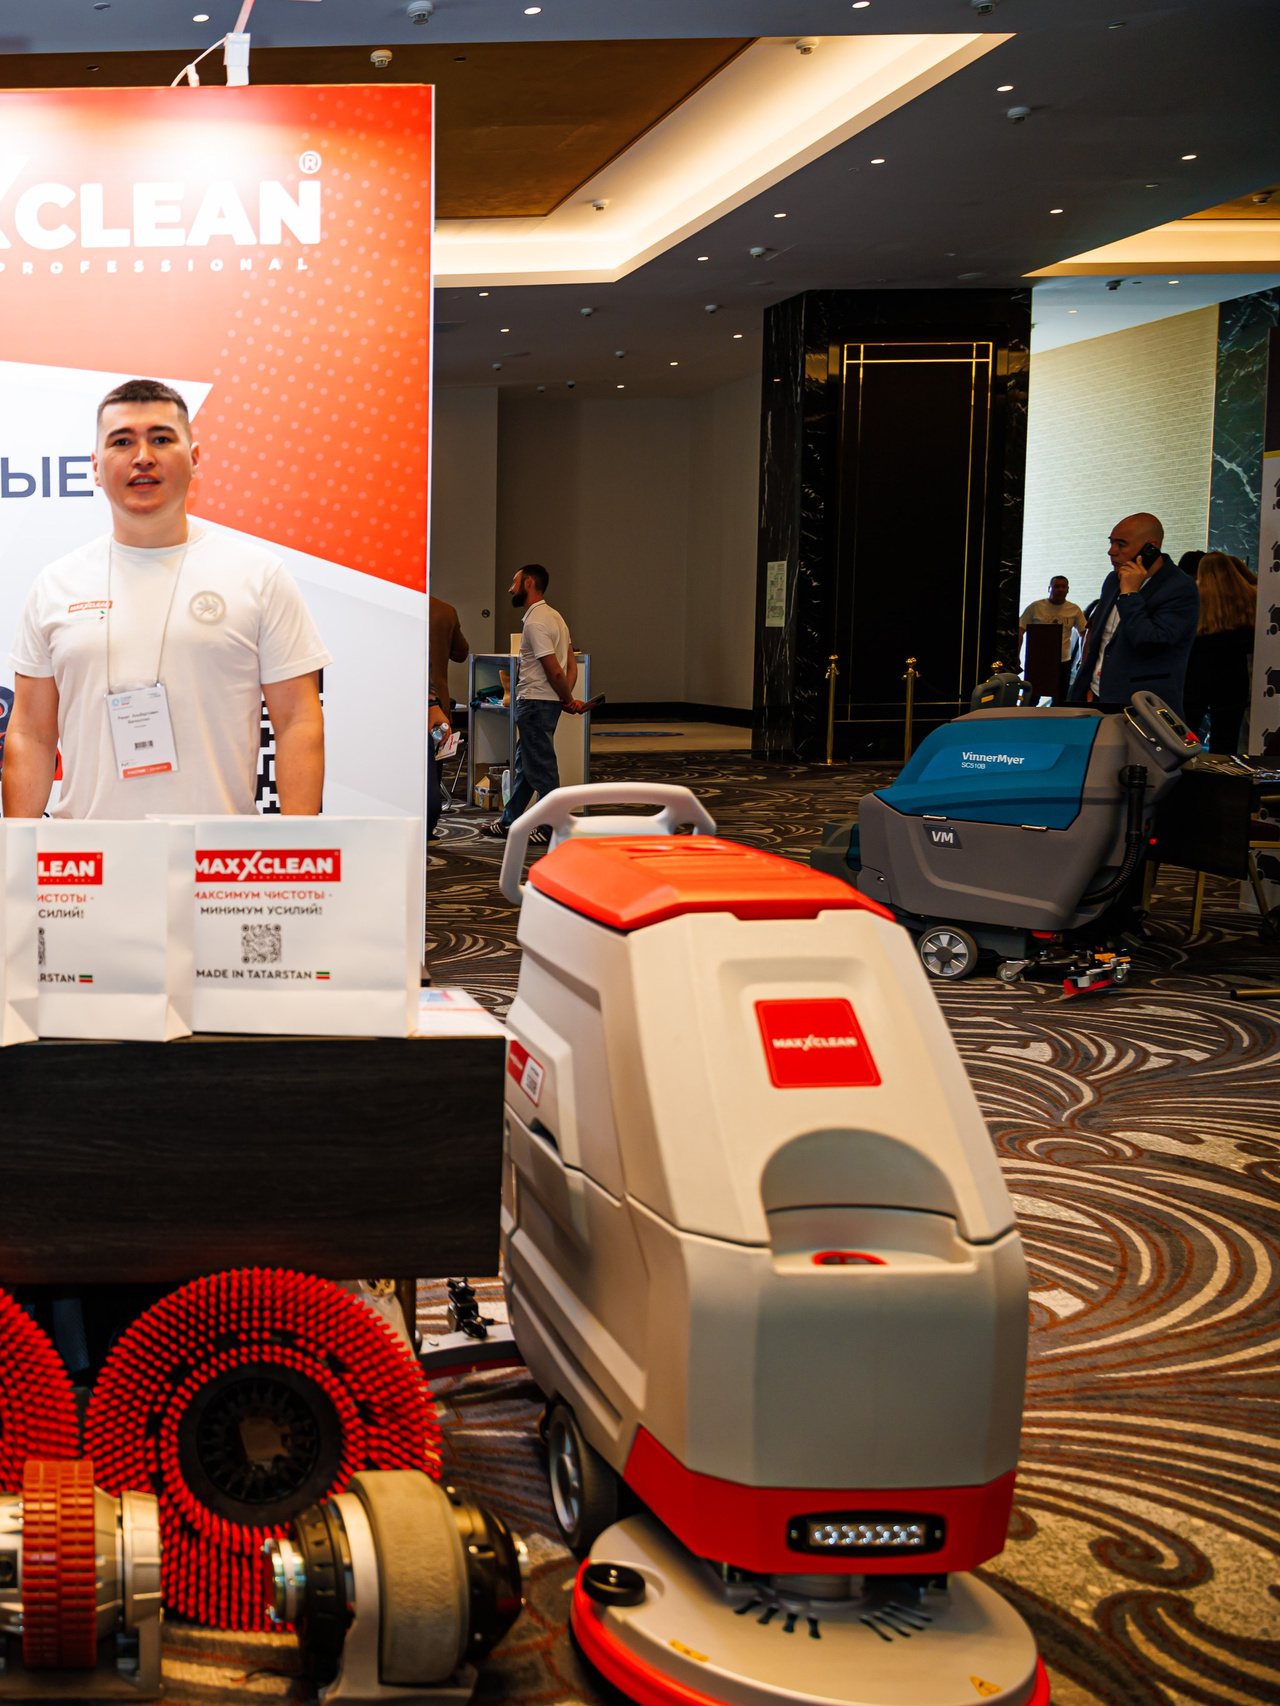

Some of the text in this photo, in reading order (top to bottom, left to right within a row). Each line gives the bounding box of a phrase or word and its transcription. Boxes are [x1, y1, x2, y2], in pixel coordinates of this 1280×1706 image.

[962, 751, 1025, 766] VinnerMyer
[931, 830, 954, 844] VM
[37, 860, 96, 878] LEAN
[195, 850, 334, 882] MAXXCLEAN
[264, 889, 325, 900] ЧИСТОТЫ
[38, 906, 84, 919] СИЛИЙ!
[200, 903, 323, 916] МИНИМУМ УСИЛИЙ!
[38, 973, 76, 984] RSTAN
[196, 969, 312, 980] MADE IN TATARSTAN
[771, 1033, 858, 1052] MAXXCLEAN
